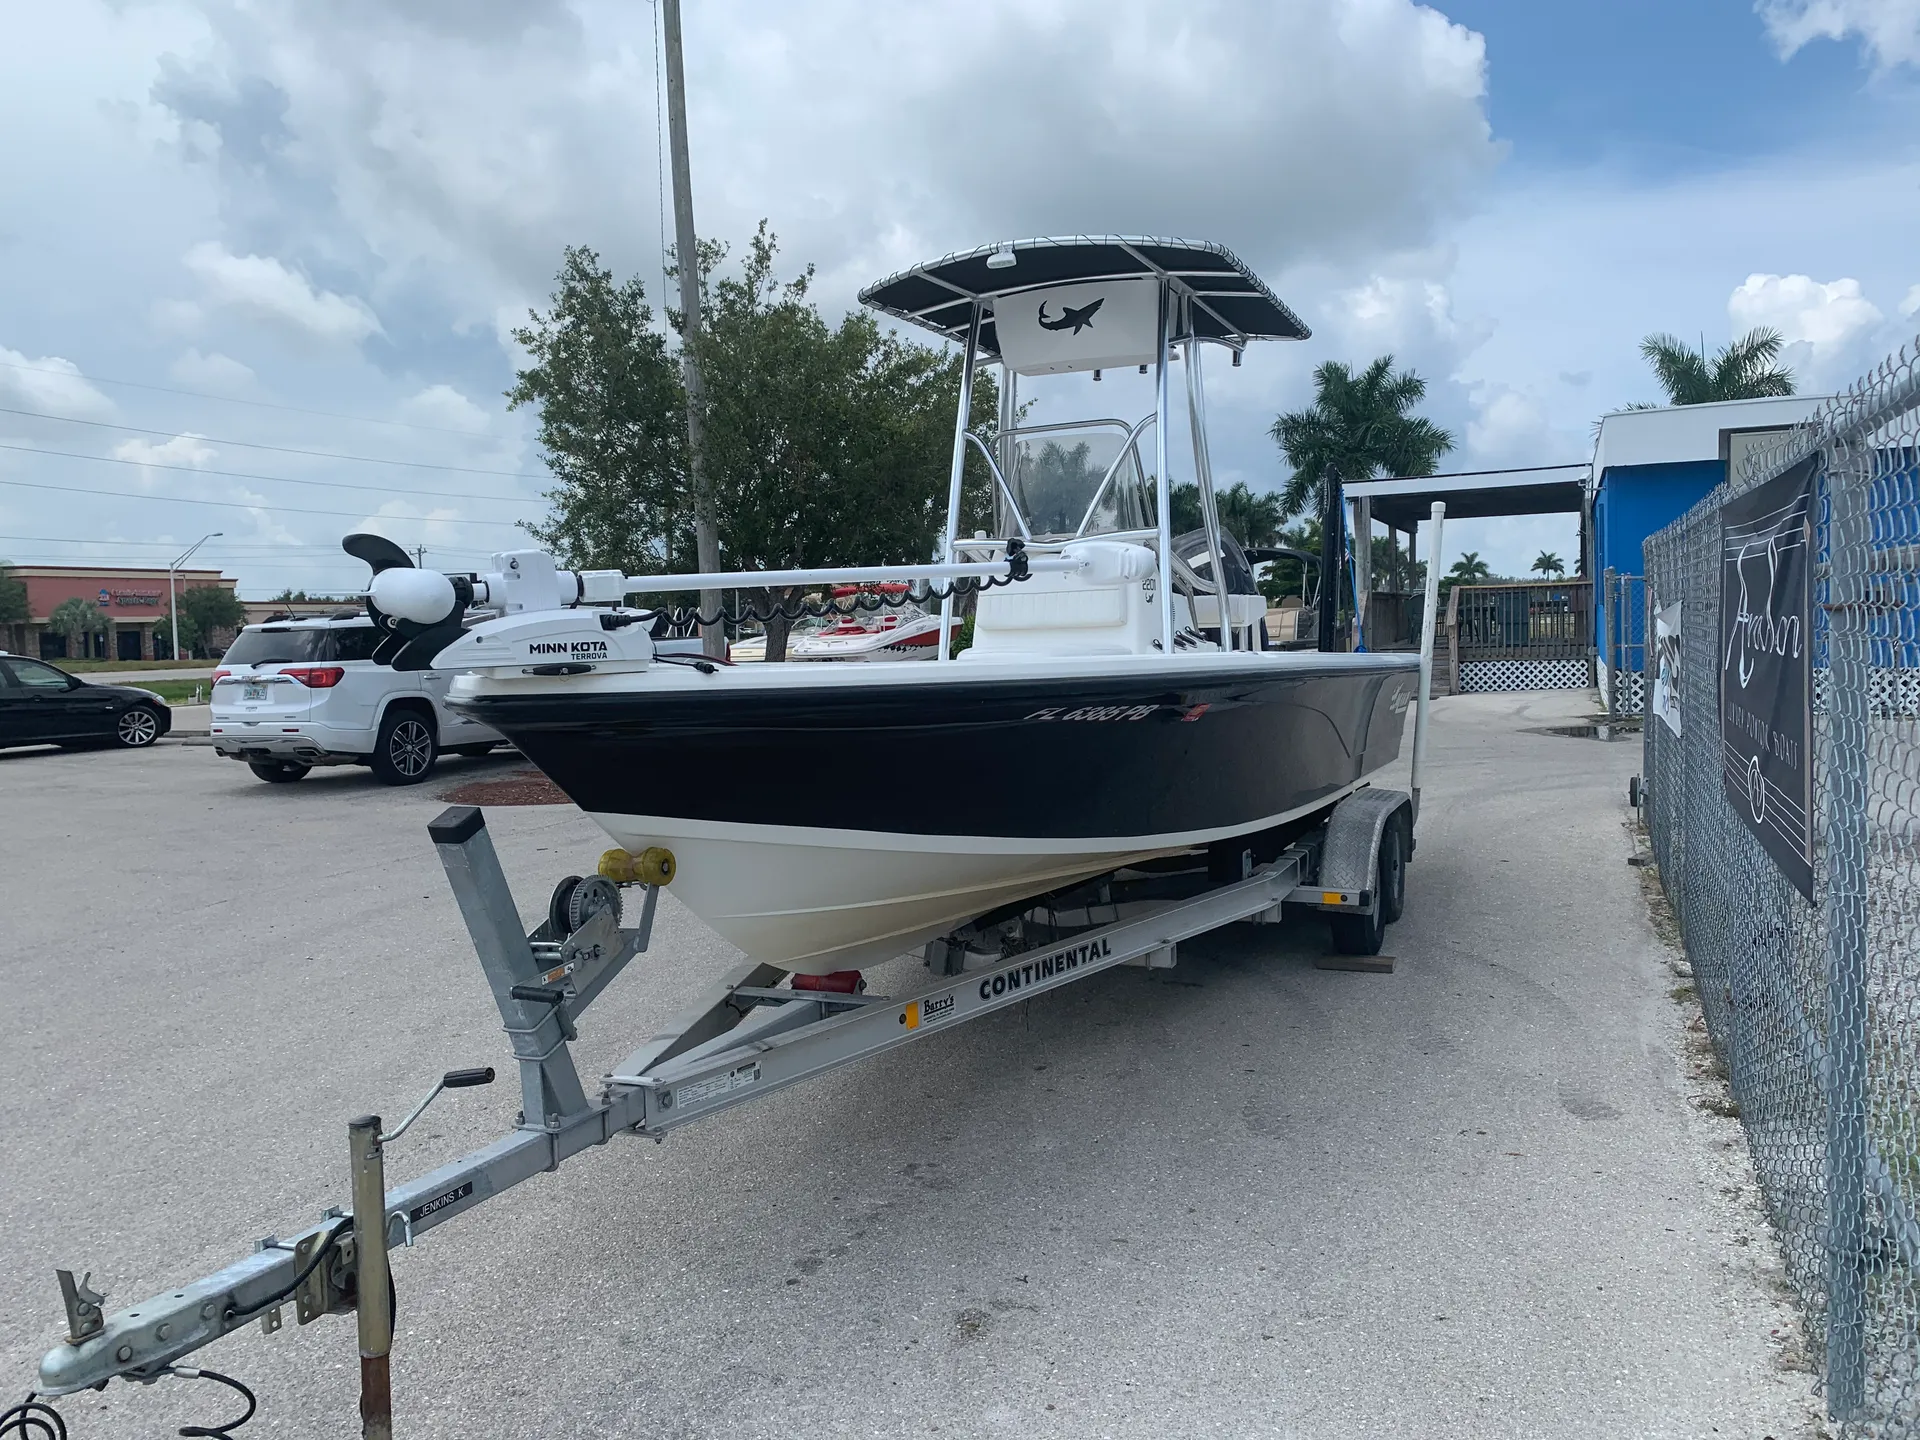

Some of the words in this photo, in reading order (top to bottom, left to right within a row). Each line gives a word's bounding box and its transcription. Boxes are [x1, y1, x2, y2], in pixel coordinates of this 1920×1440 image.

[529, 643, 568, 654] MINN
[571, 641, 608, 653] KOTA
[571, 652, 608, 661] TERROVA
[1023, 707, 1067, 720] FL
[1115, 704, 1160, 721] PB
[979, 937, 1112, 1001] CONTINENTAL
[924, 993, 955, 1013] Barry's
[420, 1191, 455, 1217] JENKINS
[458, 1186, 465, 1198] K
